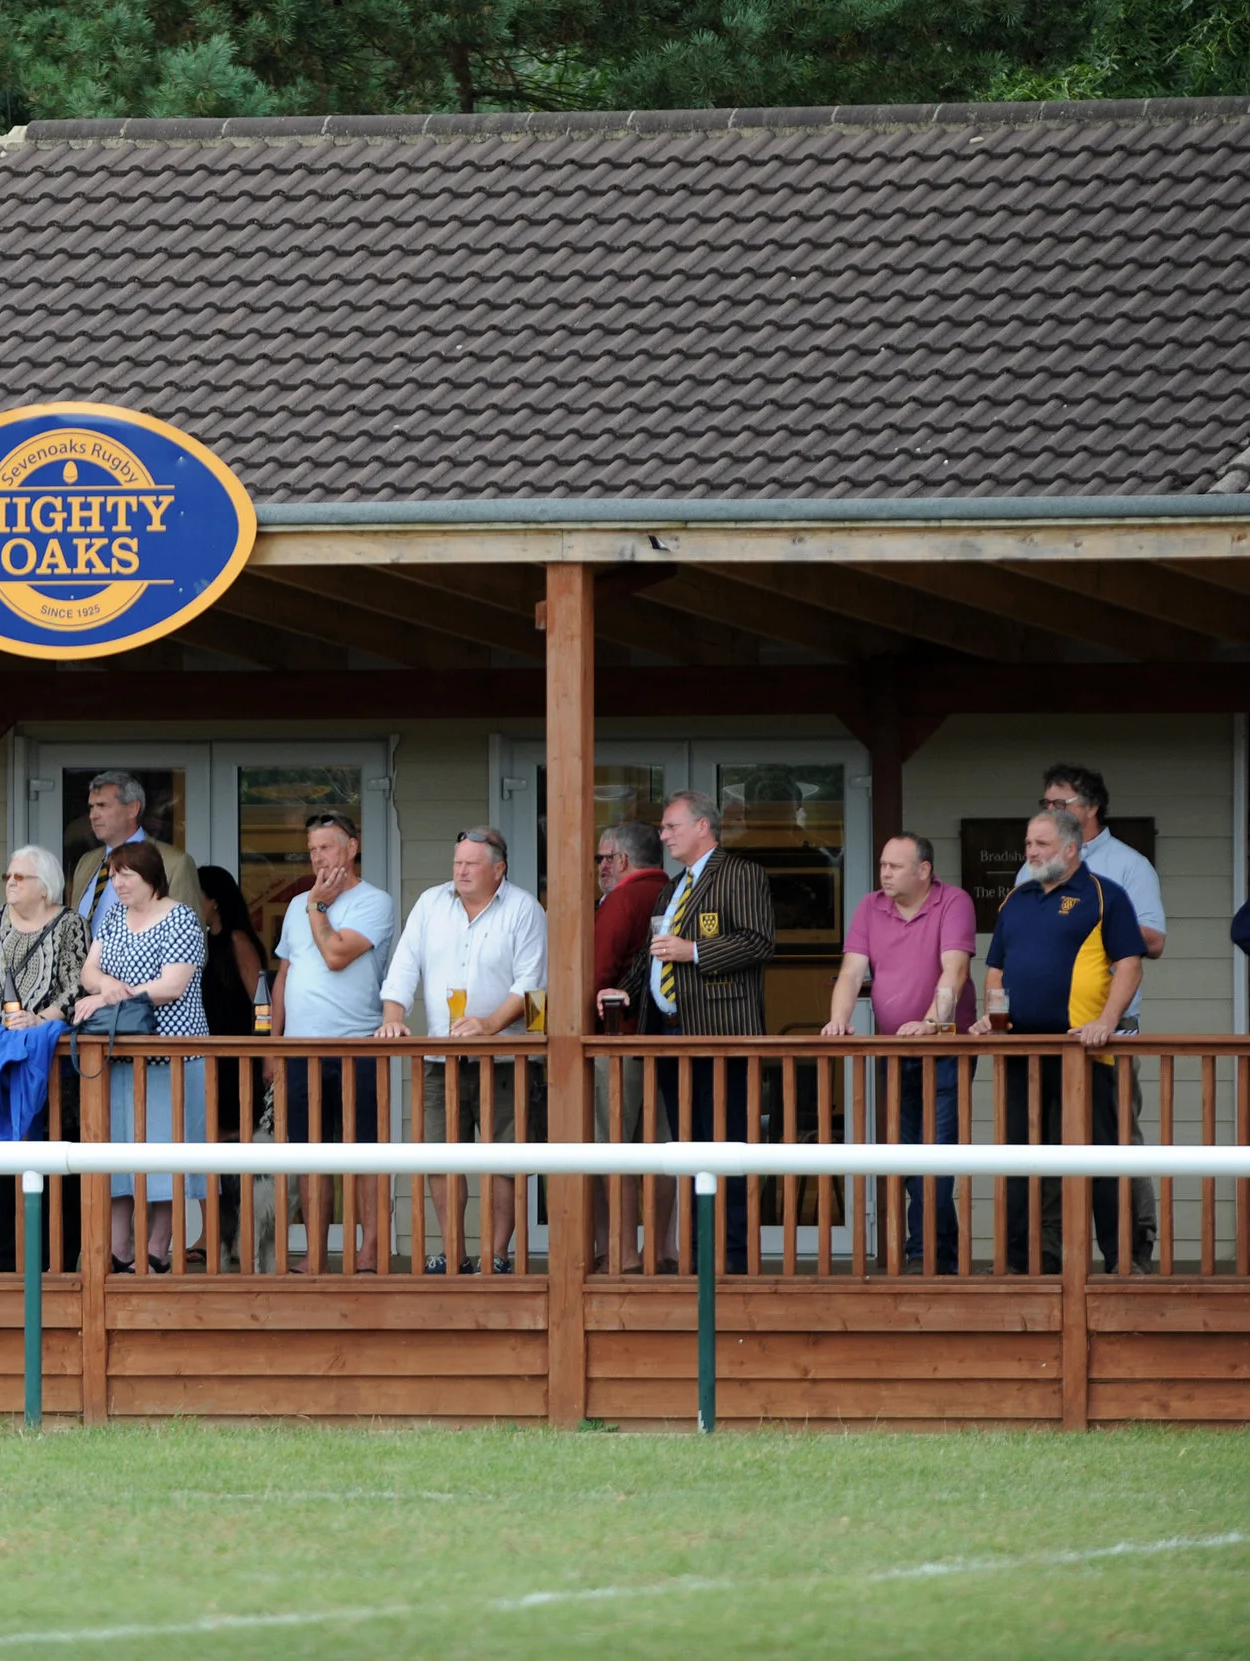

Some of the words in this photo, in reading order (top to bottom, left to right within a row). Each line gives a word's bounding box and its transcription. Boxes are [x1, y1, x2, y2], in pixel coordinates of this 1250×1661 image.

[1, 438, 87, 486] Sevenoaks
[91, 442, 139, 484] Rugby
[0, 537, 140, 576] OAKS
[41, 604, 73, 619] SINCE
[77, 604, 101, 618] 1925
[980, 850, 1027, 862] Bradsha
[974, 886, 996, 898] The
